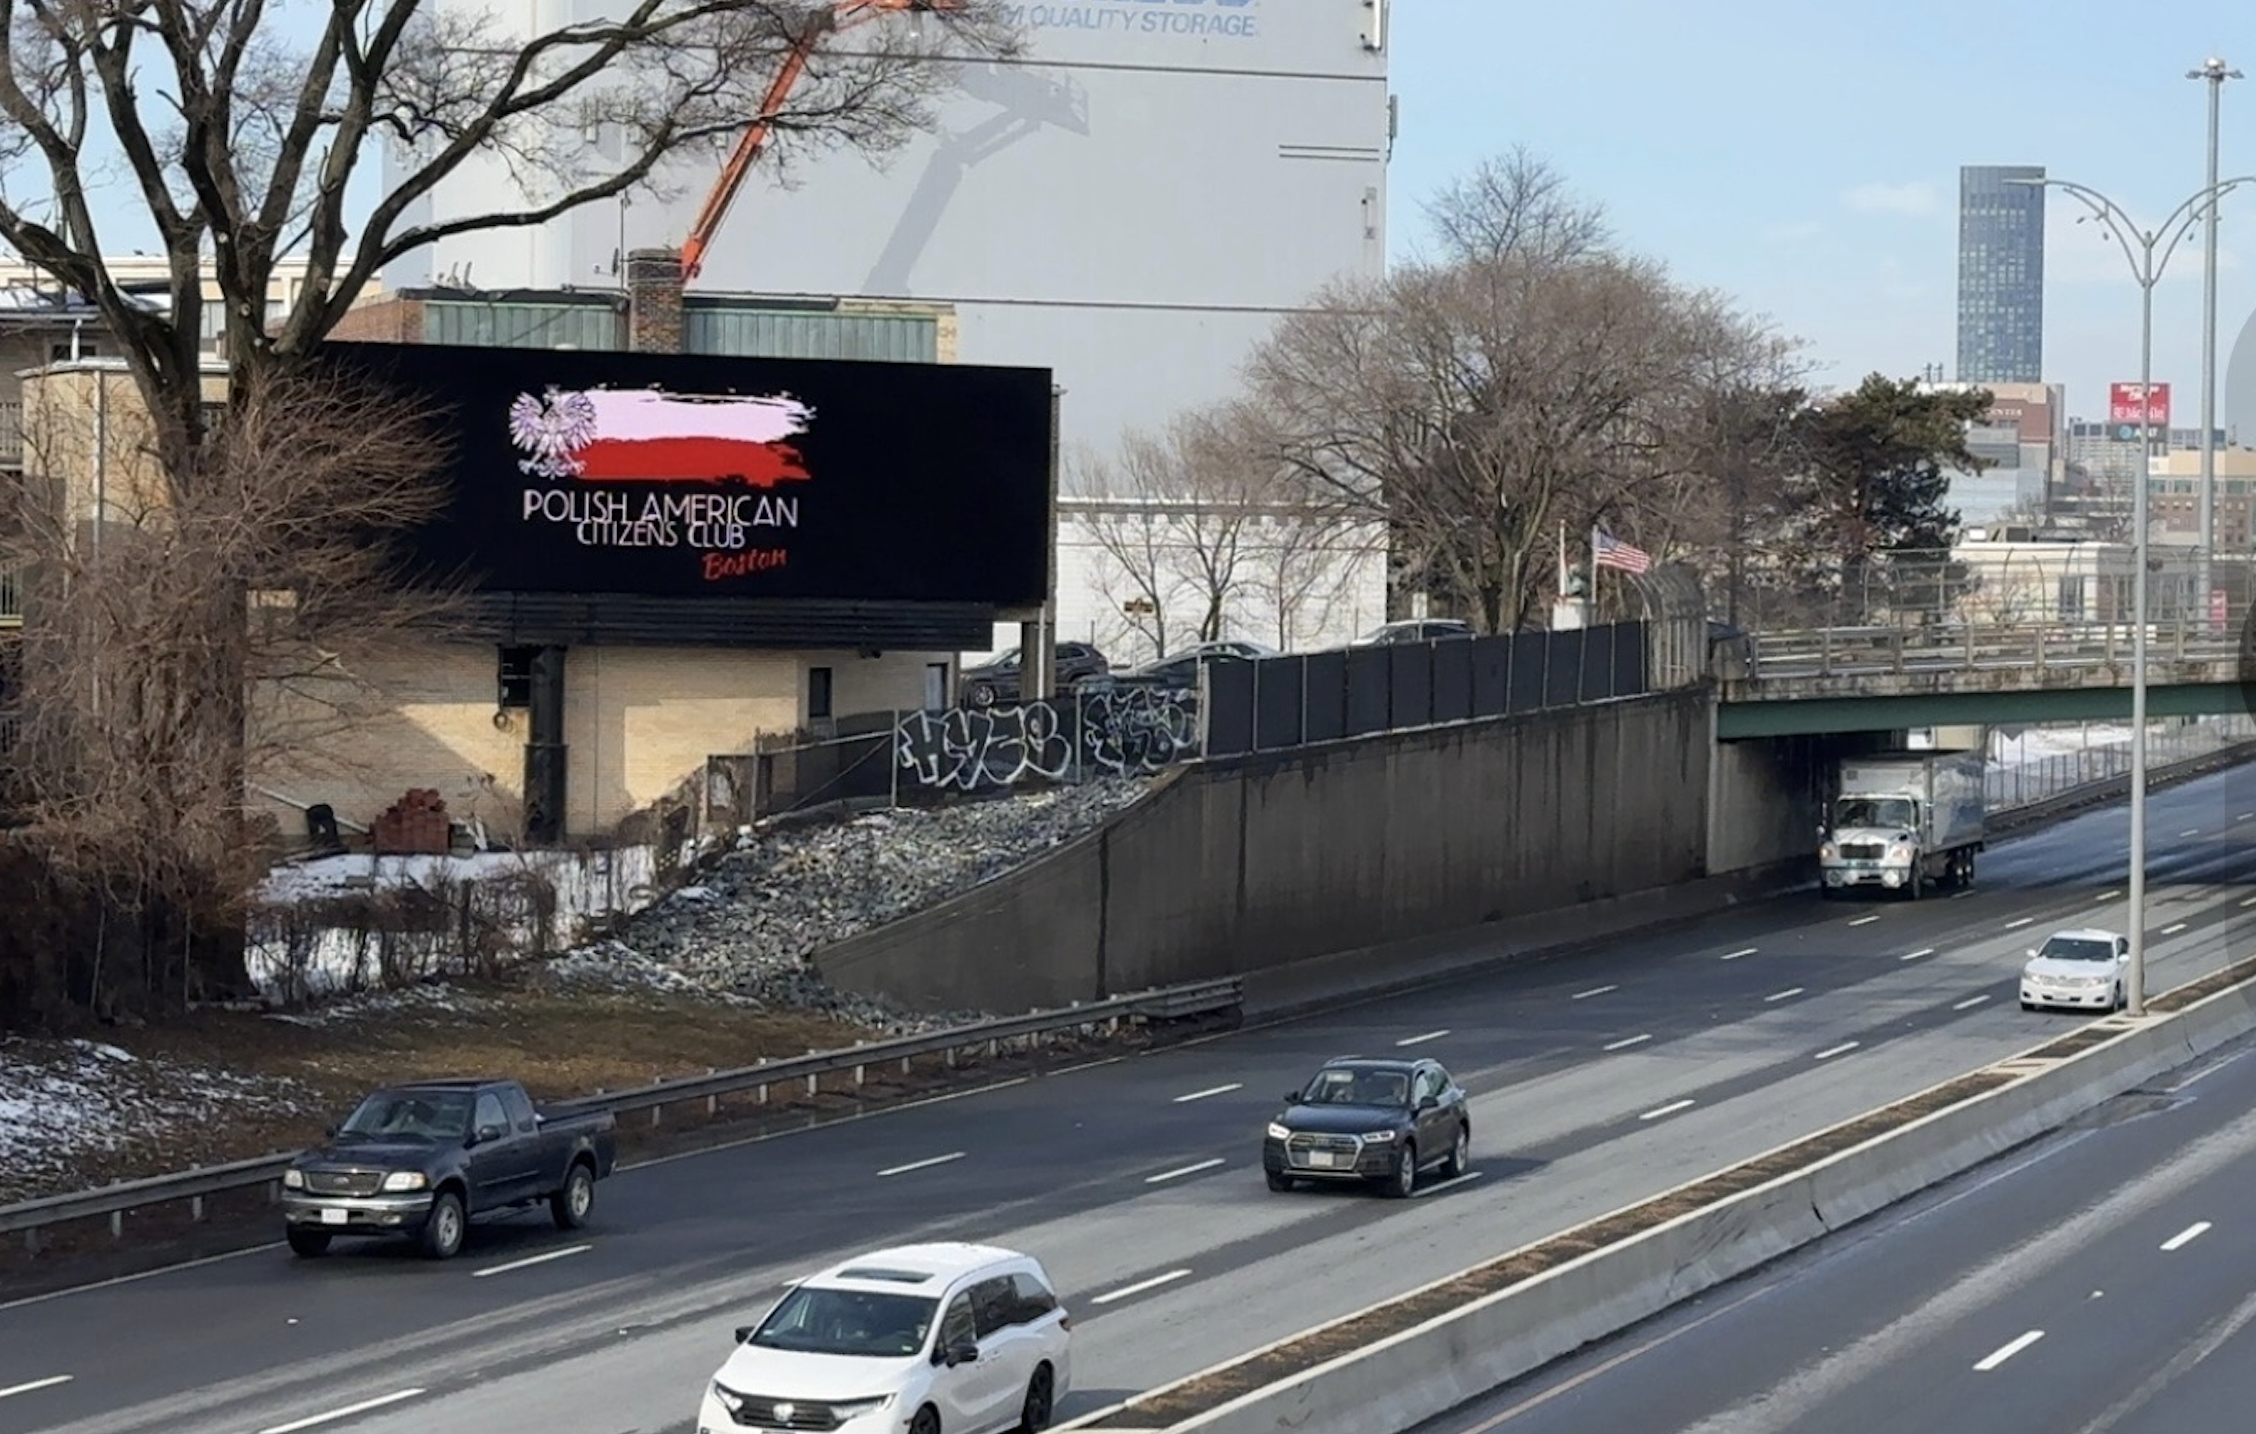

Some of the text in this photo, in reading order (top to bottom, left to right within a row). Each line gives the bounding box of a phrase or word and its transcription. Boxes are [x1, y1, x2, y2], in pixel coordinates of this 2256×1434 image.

[1029, 5, 1137, 31] QUALITY
[1140, 11, 1257, 37] STORAGE
[522, 489, 799, 528] POLISH AMERICAN
[576, 520, 746, 549] CITIZENS CLUB
[702, 549, 787, 580] Boston
